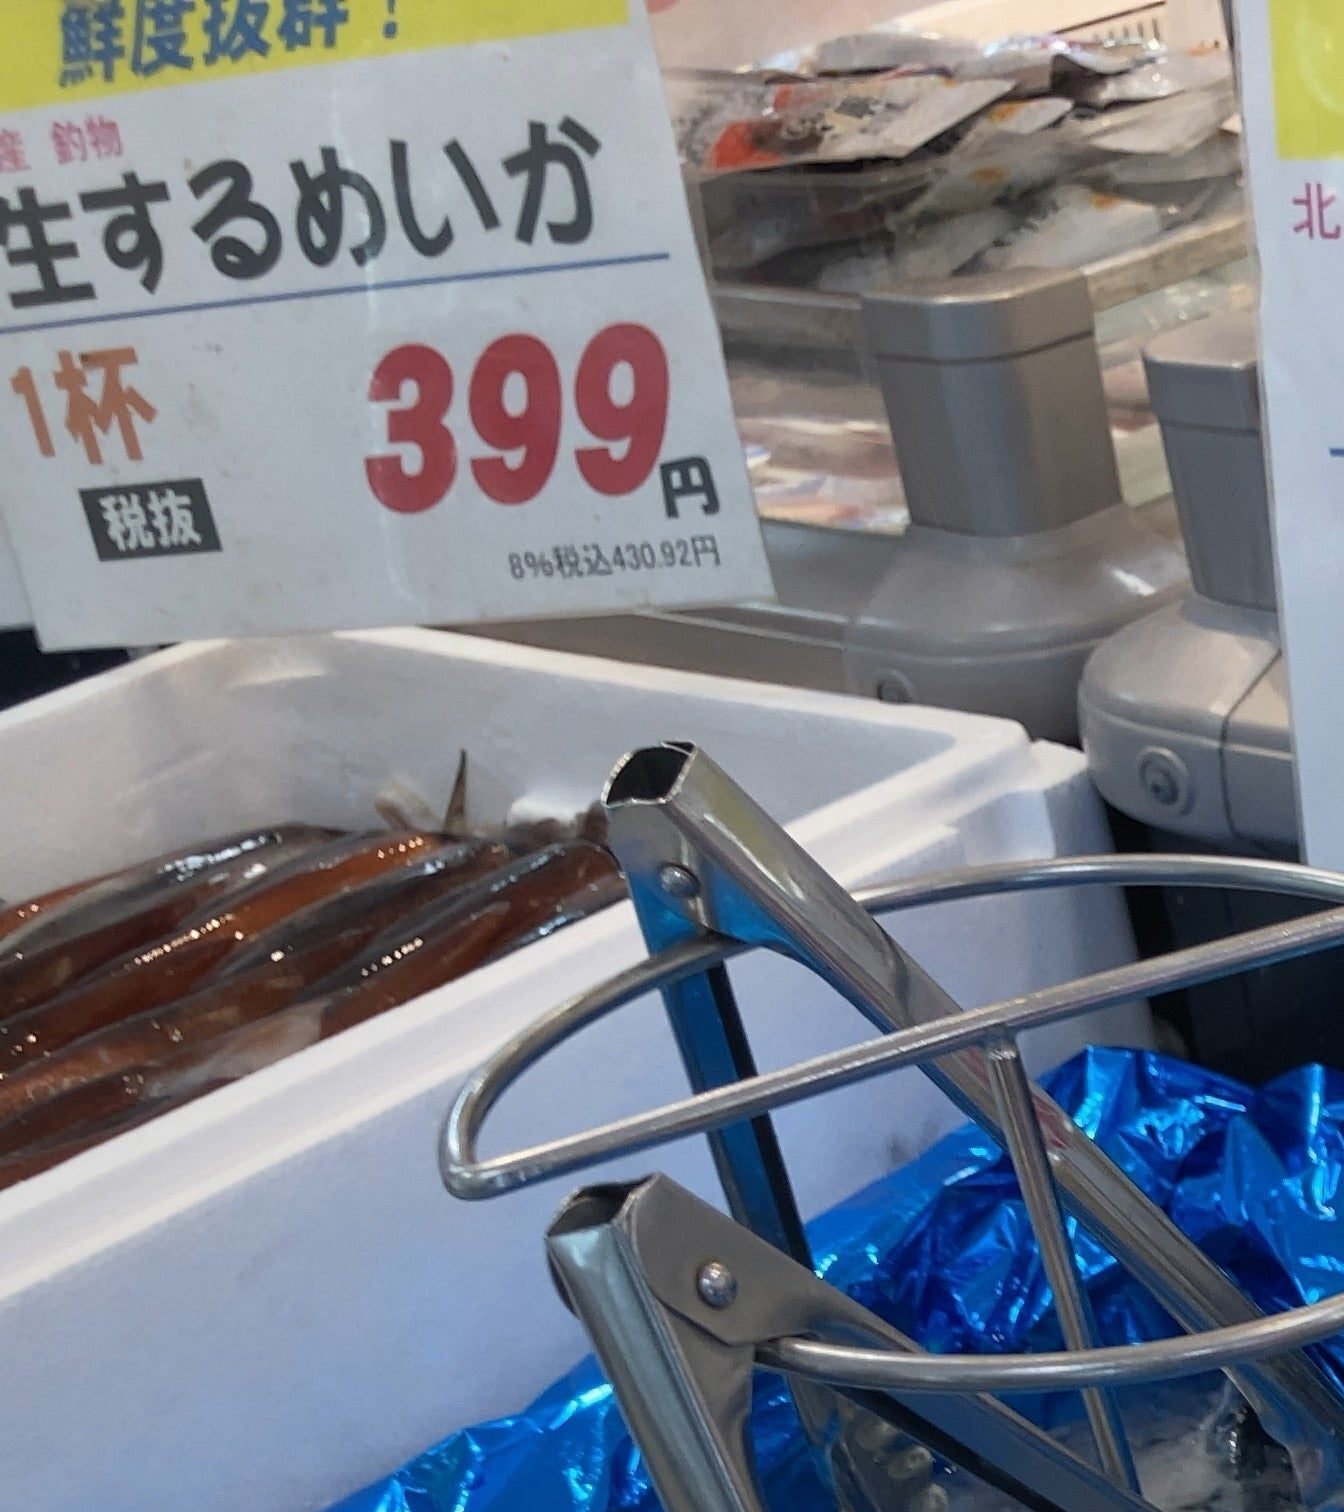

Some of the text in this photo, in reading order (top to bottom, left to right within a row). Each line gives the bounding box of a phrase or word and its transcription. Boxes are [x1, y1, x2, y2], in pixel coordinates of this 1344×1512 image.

[0, 116, 602, 309] 生するめいか
[10, 345, 158, 465] 1杯
[99, 487, 202, 551] 税抜
